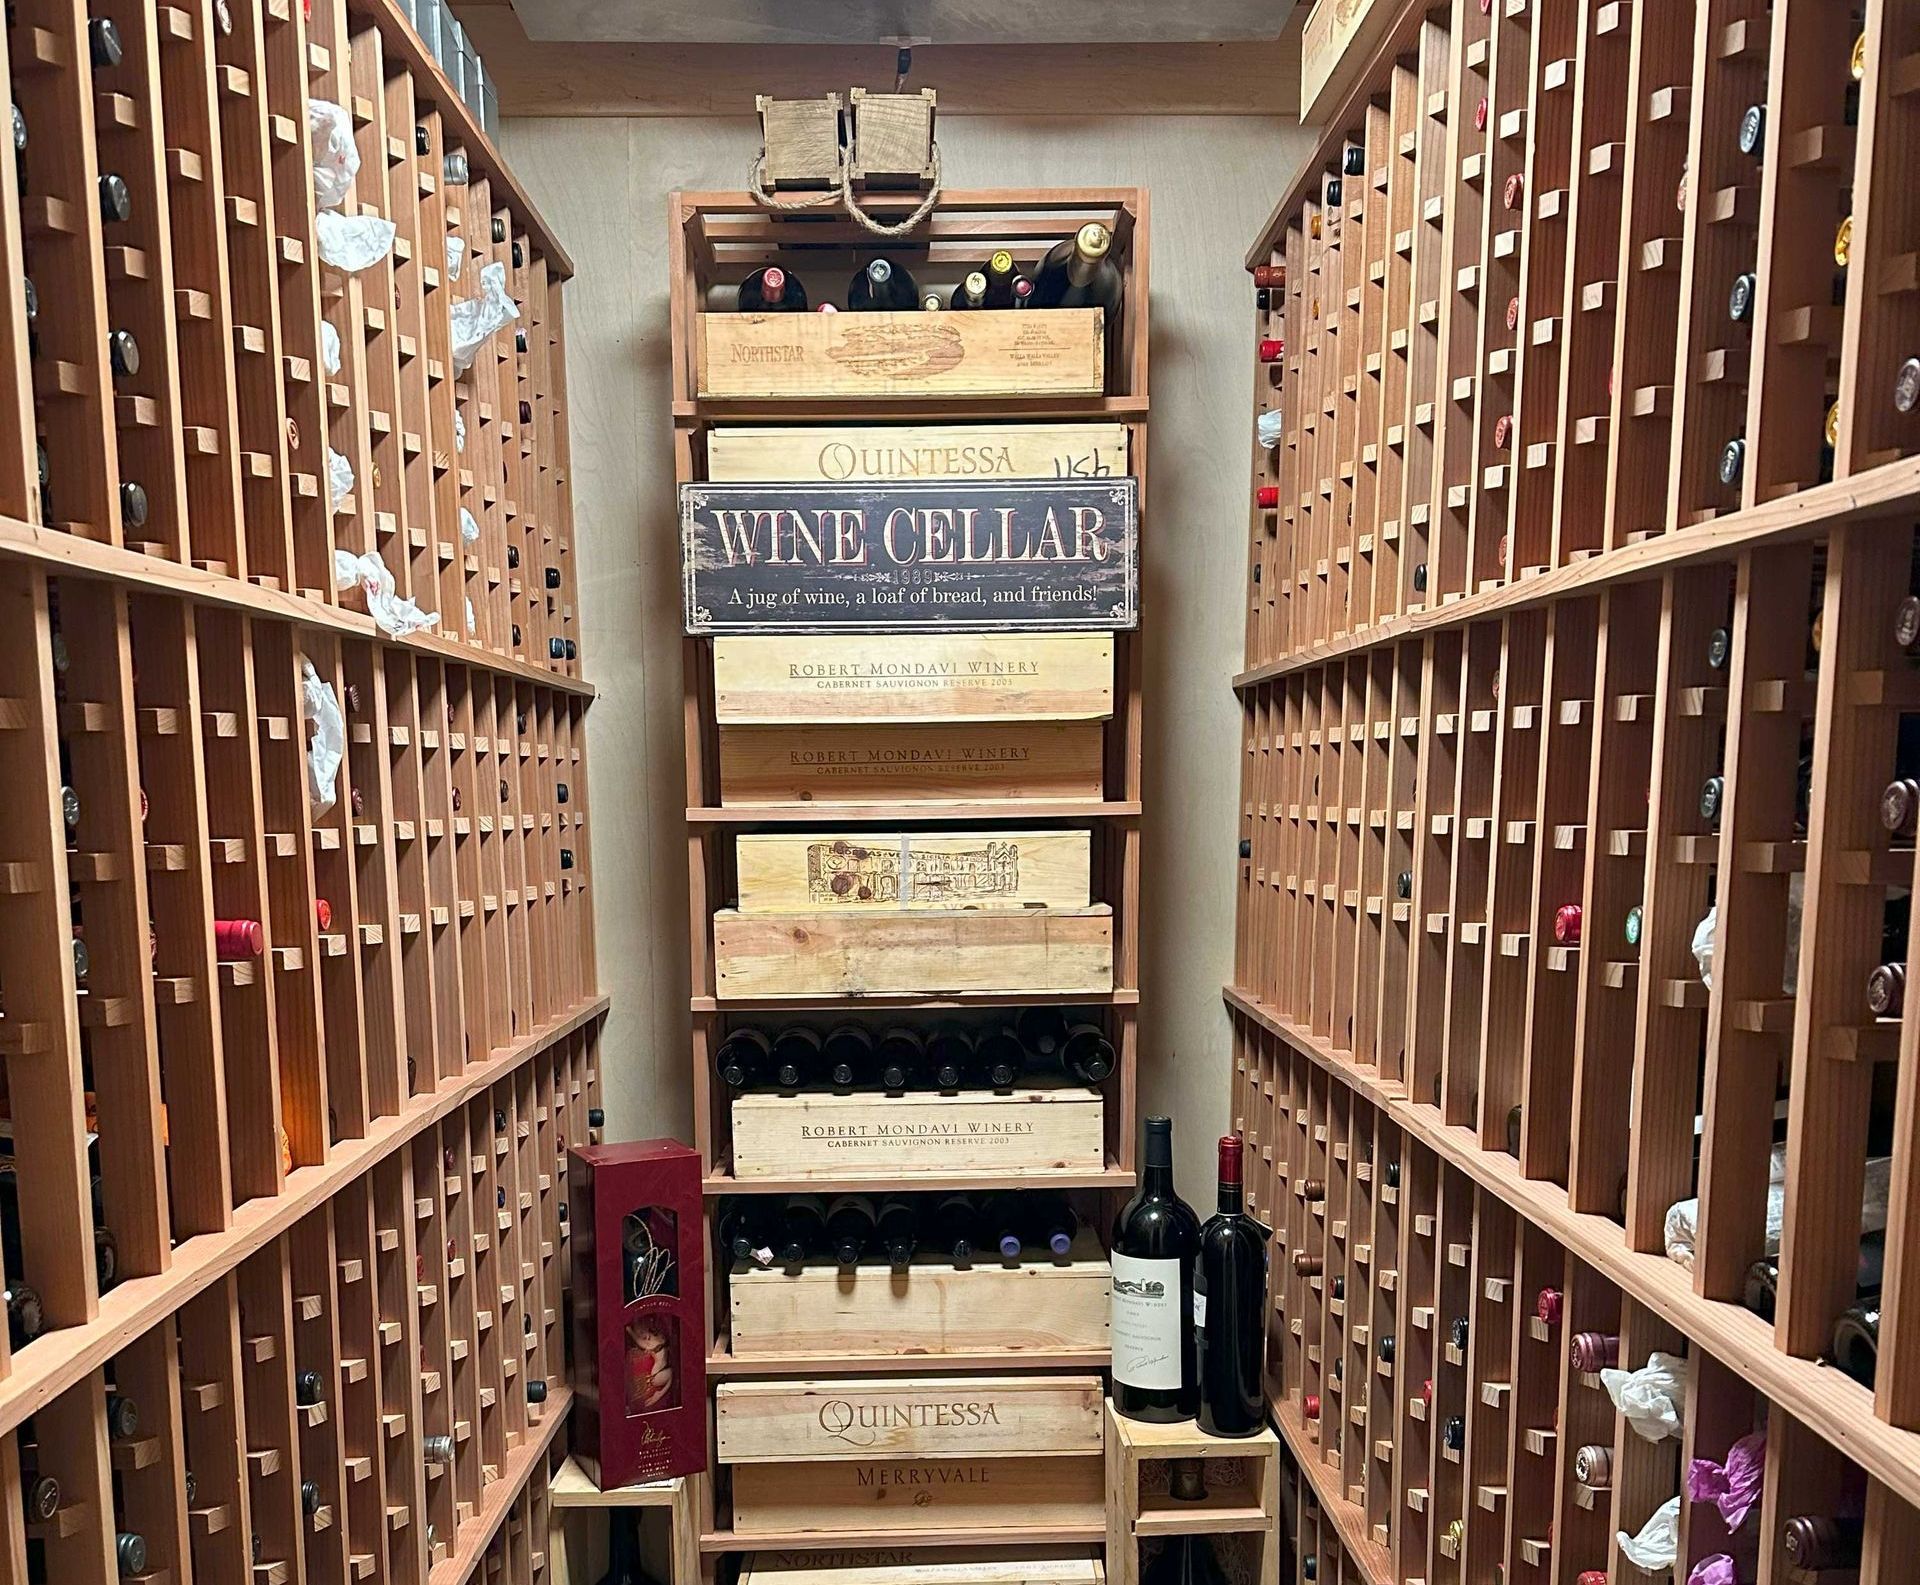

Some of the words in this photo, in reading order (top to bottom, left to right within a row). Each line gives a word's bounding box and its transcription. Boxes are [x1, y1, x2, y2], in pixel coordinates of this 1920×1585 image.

[731, 344, 803, 363] NORTHSTAR
[819, 443, 1016, 480] QUINTESSA
[710, 508, 868, 567] WINE
[883, 506, 1110, 566] CELLAR
[893, 568, 933, 585] 1989
[728, 588, 743, 605] A
[746, 588, 775, 609] jug
[782, 587, 800, 605] of
[804, 588, 850, 607] wine,
[856, 592, 866, 604] a
[872, 587, 903, 604] loaf
[910, 587, 929, 604] of
[932, 587, 987, 607] bread,
[993, 586, 1026, 604] and
[1031, 585, 1098, 603] friends!
[790, 664, 861, 676] ROBERT
[871, 662, 958, 676] MONDAVI
[968, 661, 1039, 674] WINERY
[817, 680, 871, 689] CABERNET
[876, 679, 939, 688] SAUVIGNON
[943, 678, 987, 688] RESERVE
[790, 750, 858, 762] ROBERT
[868, 749, 952, 761] MONDAVI
[962, 747, 1030, 760] WINERY
[817, 766, 870, 775] CABERNET
[874, 765, 934, 774] SAUVIGNON
[938, 764, 980, 773] RESERVE
[801, 1125, 868, 1137] ROBERT
[877, 1123, 958, 1136] MONDAVI
[968, 1122, 1034, 1134] WINERY
[827, 1139, 878, 1148] CABERNET
[882, 1138, 941, 1147] SAUVIGNON
[945, 1137, 986, 1146] RESERVE
[818, 1400, 1000, 1446] QUINTESSA
[857, 1467, 990, 1486] MERRYVALE
[776, 1551, 914, 1568] NORTHSTAR
